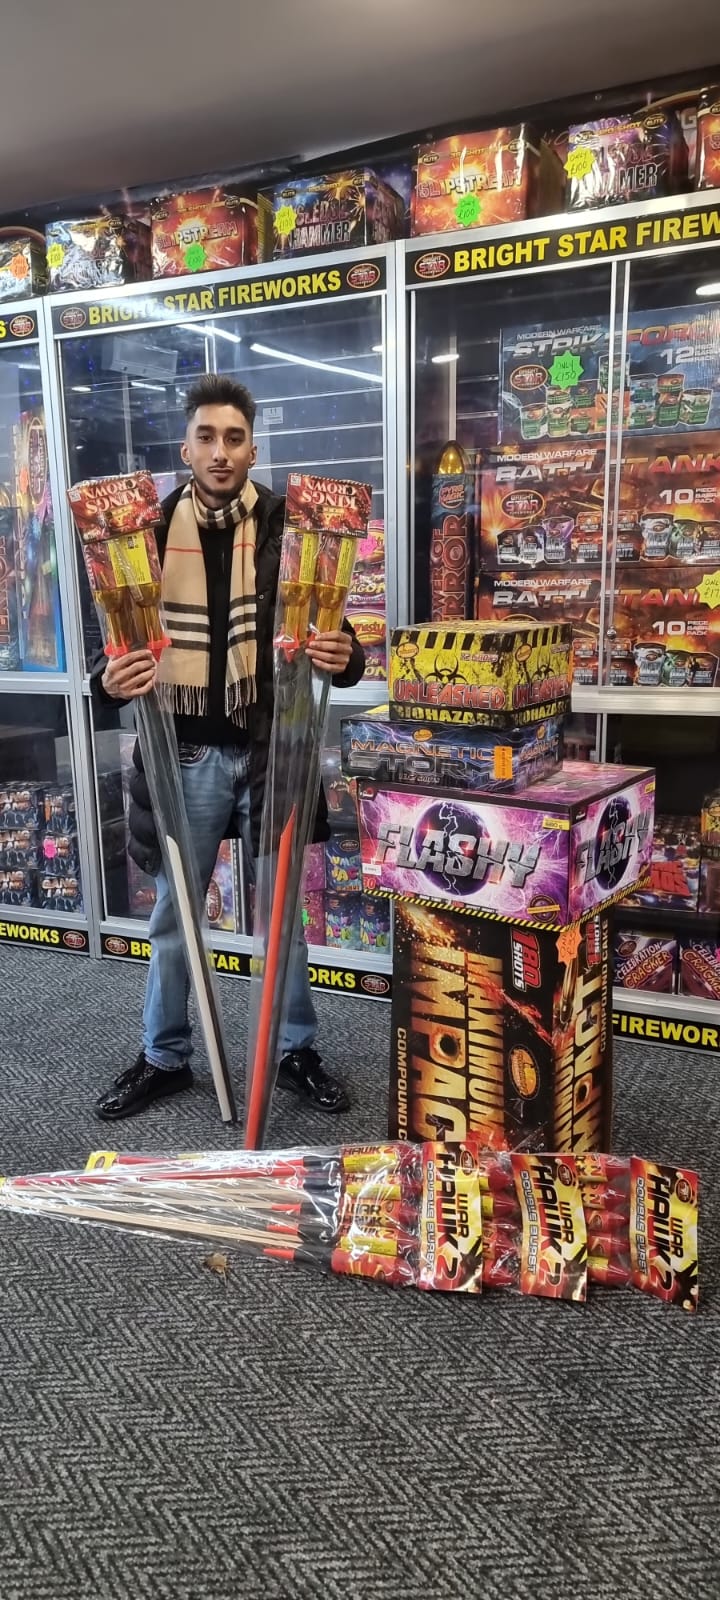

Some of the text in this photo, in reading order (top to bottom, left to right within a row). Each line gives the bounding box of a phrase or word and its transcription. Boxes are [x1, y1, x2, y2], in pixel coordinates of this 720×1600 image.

[454, 237, 550, 273] BRIGHT
[557, 225, 628, 258] STAR
[88, 270, 341, 326] BRIGHT STAR FIREWORKS
[517, 324, 601, 341] MODERN WARFARE
[514, 373, 543, 384] STAR
[660, 347, 694, 365] 12
[497, 448, 598, 463] MODERN WARFARE
[84, 478, 137, 499] CROWN
[85, 488, 143, 514] KINGS
[302, 489, 358, 510] KINGS
[304, 479, 357, 497] CROWN
[505, 499, 539, 512] STAR
[659, 488, 694, 505] 10
[432, 528, 446, 622] OWER OF
[442, 511, 468, 621] RROR
[494, 578, 592, 588] MODERN WARFARE
[620, 588, 700, 606] TAN
[652, 620, 686, 636] 10
[393, 679, 506, 710] UNLEASHED
[351, 738, 495, 762] MAGNETIC
[377, 823, 542, 889] FLASHY
[576, 810, 651, 885] FLASHY
[592, 914, 601, 954] SHOTS
[512, 940, 526, 991] SHOTS
[513, 930, 541, 988] 180
[615, 942, 663, 981] CELEBRATION
[623, 950, 673, 989] CRACKER
[600, 919, 609, 1052] COMPOUND CAKE
[411, 943, 467, 1143] IMPAC
[467, 952, 504, 1136] MAXIMUM
[573, 973, 602, 1153] MPACT
[397, 1027, 408, 1126] COMPOUND
[348, 1203, 382, 1216] WAR
[425, 1160, 436, 1272] DOUBLE BURST
[436, 1153, 459, 1281] HAWK 2
[457, 1193, 469, 1239] WAR
[520, 1170, 539, 1273] DOUBLE BURST
[531, 1165, 562, 1286] HAWK 2
[558, 1200, 575, 1245] WAR
[636, 1177, 649, 1274] DOUBLE BURST
[647, 1173, 674, 1291] HAWK 2
[670, 1216, 685, 1259] WAR
